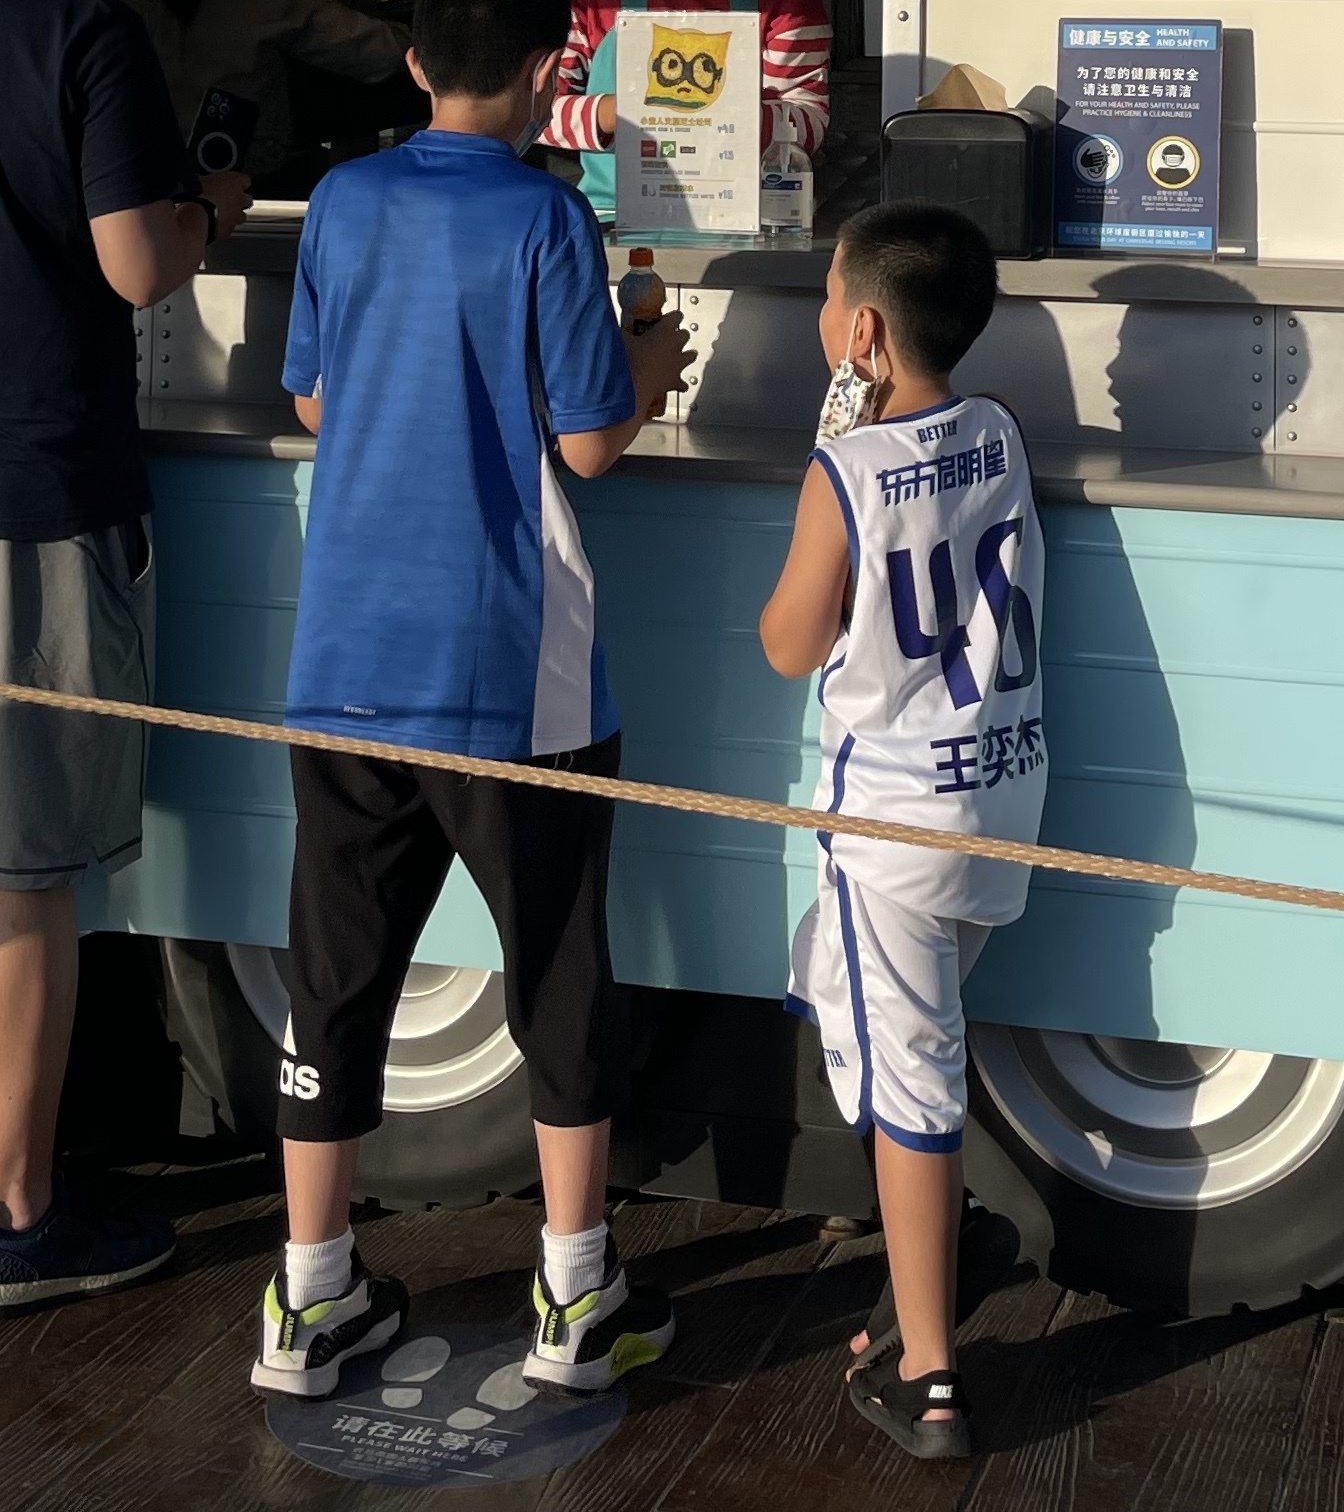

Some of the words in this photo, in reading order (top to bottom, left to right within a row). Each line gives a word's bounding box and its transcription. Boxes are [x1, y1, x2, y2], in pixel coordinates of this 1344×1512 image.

[1069, 29, 1151, 46] 健康与安全
[1157, 28, 1190, 37] HEALTH
[1156, 39, 1176, 47] AND
[1177, 39, 1209, 47] SAFETY
[1077, 66, 1200, 81] 为了您的健康和安全
[1083, 83, 1192, 98] 请注意卫生与清洁
[930, 714, 1045, 794] 王奕杰
[331, 1414, 508, 1457] 请在此等候
[341, 1435, 392, 1449] PLEASE
[394, 1444, 430, 1456] WAIT
